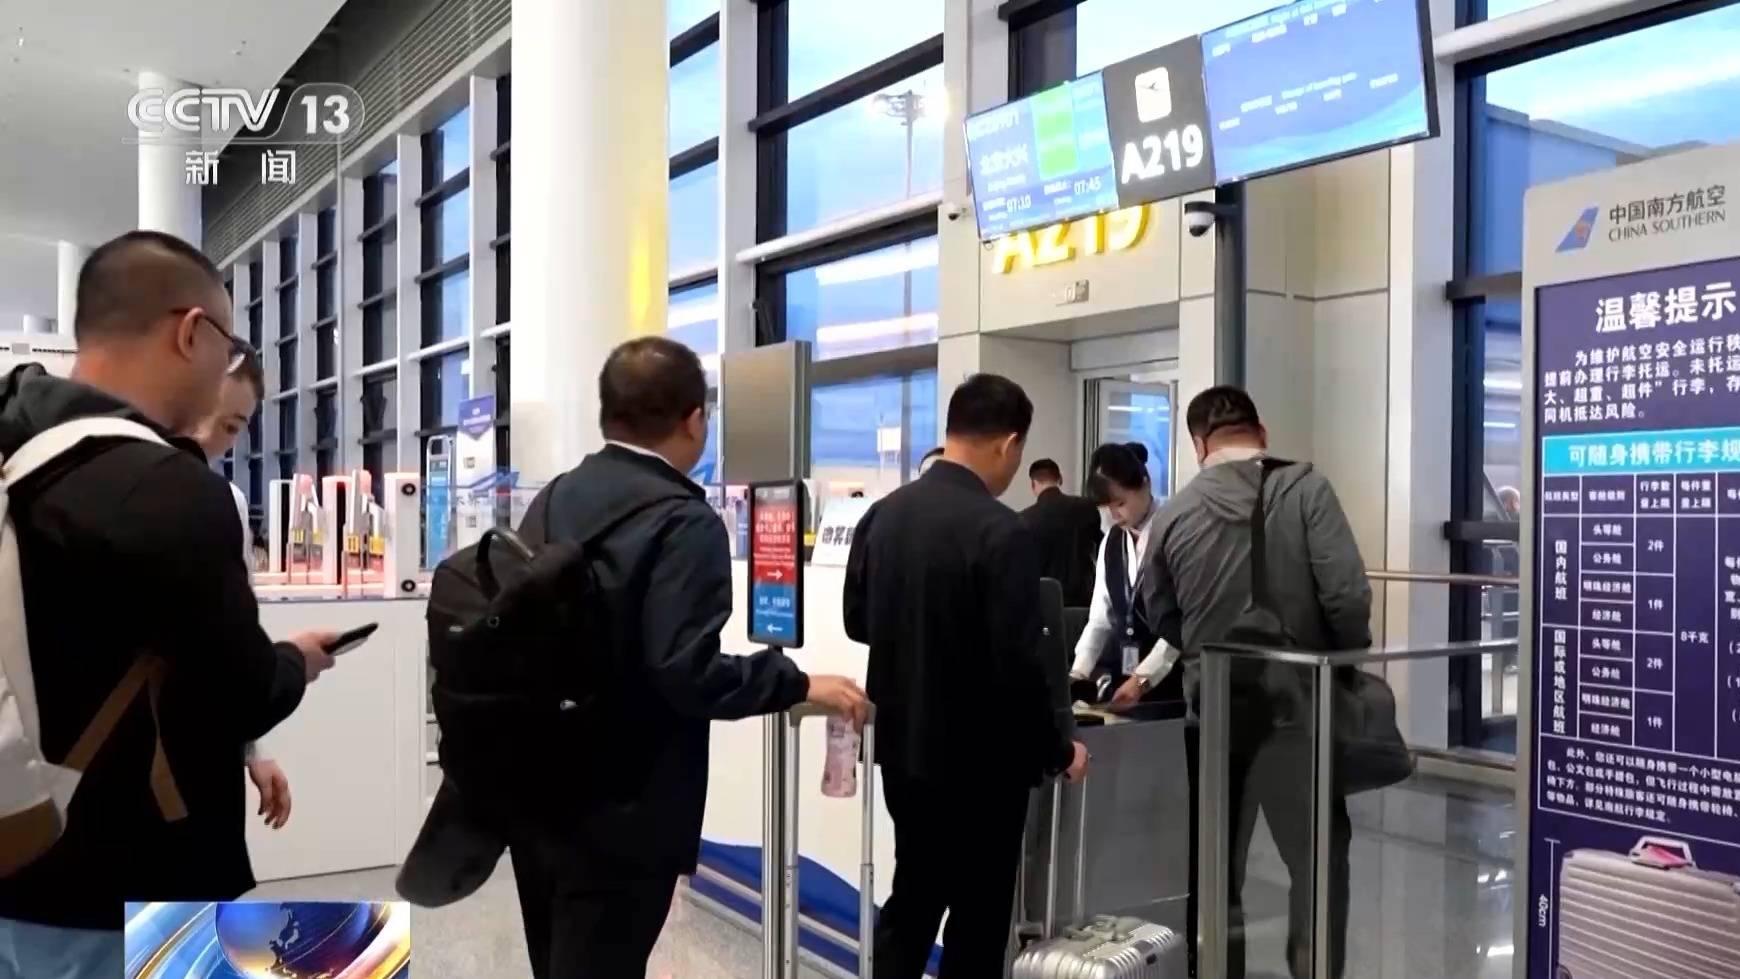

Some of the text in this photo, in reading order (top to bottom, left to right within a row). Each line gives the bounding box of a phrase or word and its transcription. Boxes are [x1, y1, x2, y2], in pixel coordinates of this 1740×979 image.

[1120, 124, 1204, 185] A219
[1608, 208, 1726, 243] CHINA SOUTHERN
[1609, 184, 1726, 226] 中国南方航空
[1596, 281, 1736, 333] 温馨提示
[1538, 894, 1549, 928] 40cm
